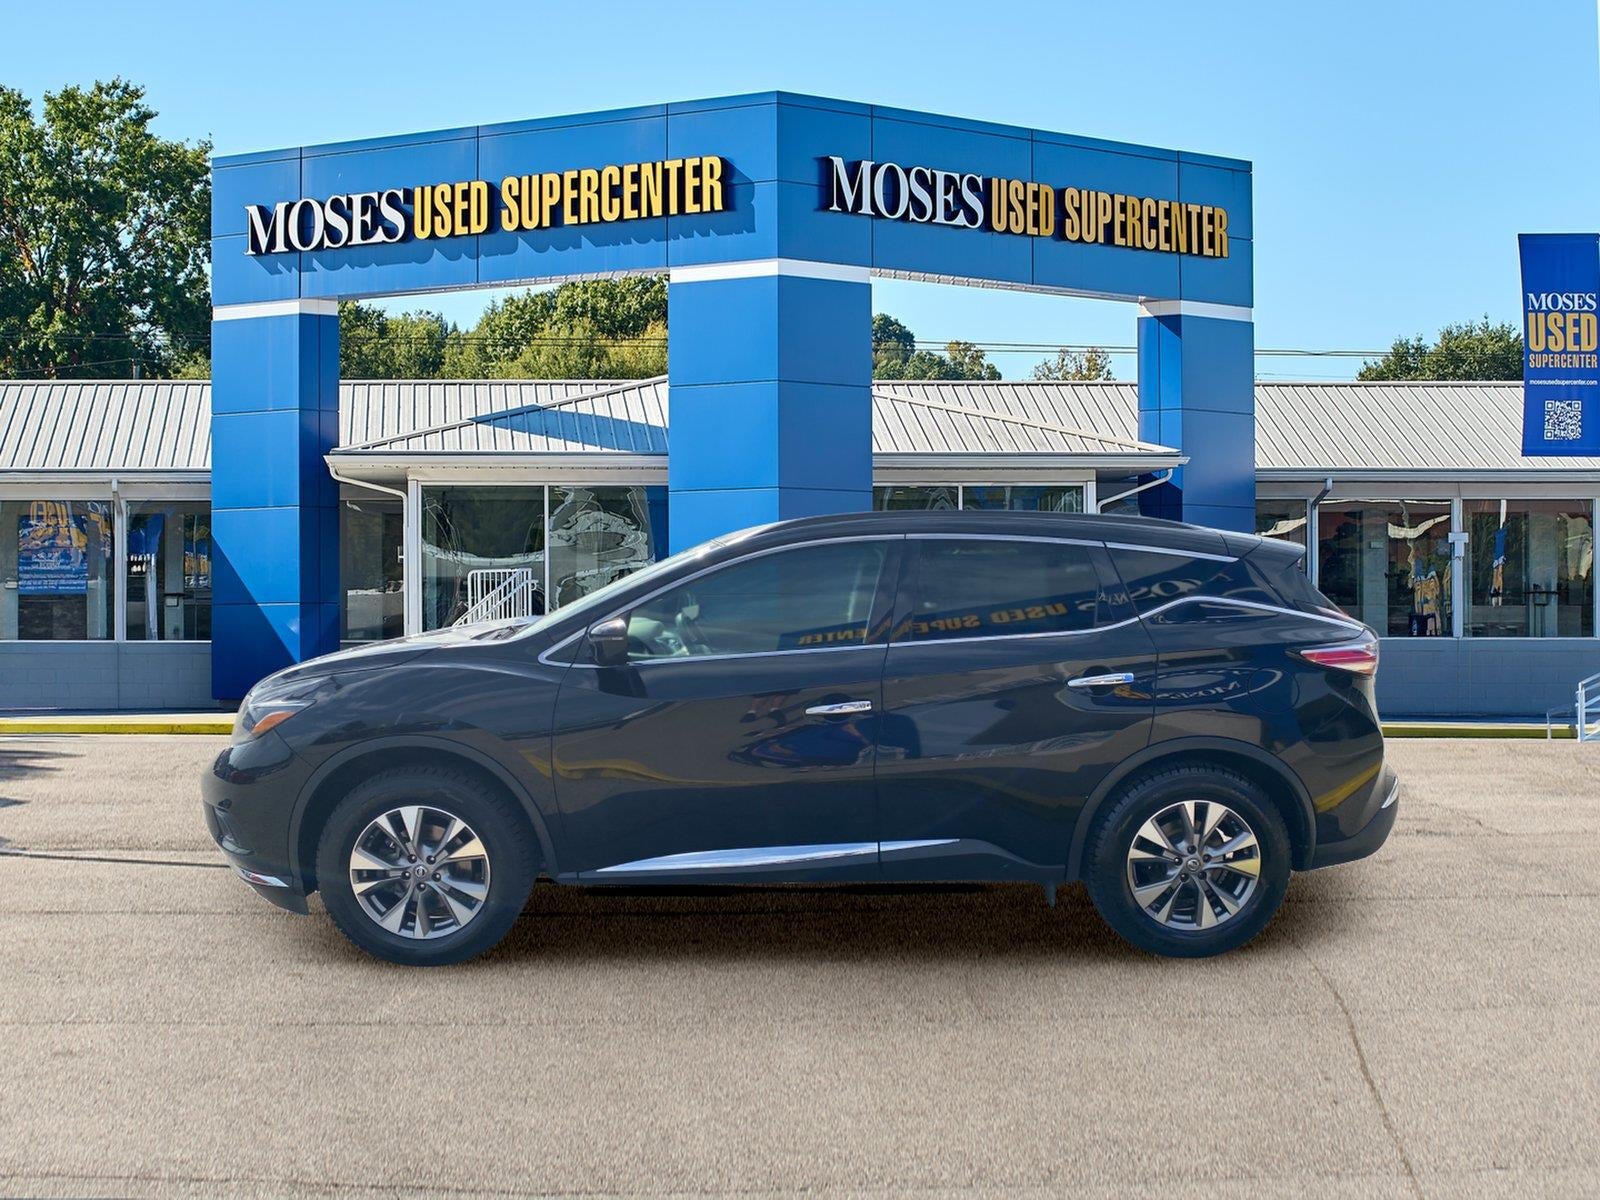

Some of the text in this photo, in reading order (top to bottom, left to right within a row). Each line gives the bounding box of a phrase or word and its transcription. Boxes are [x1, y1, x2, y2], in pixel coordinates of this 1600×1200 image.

[245, 155, 724, 256] MOSES USED SUPERCENTER
[828, 156, 1229, 258] MOSES USED SUPERCENTER
[1527, 292, 1597, 311] MOSES
[1528, 312, 1597, 352] USED
[1529, 354, 1598, 368] SUPERCENTER
